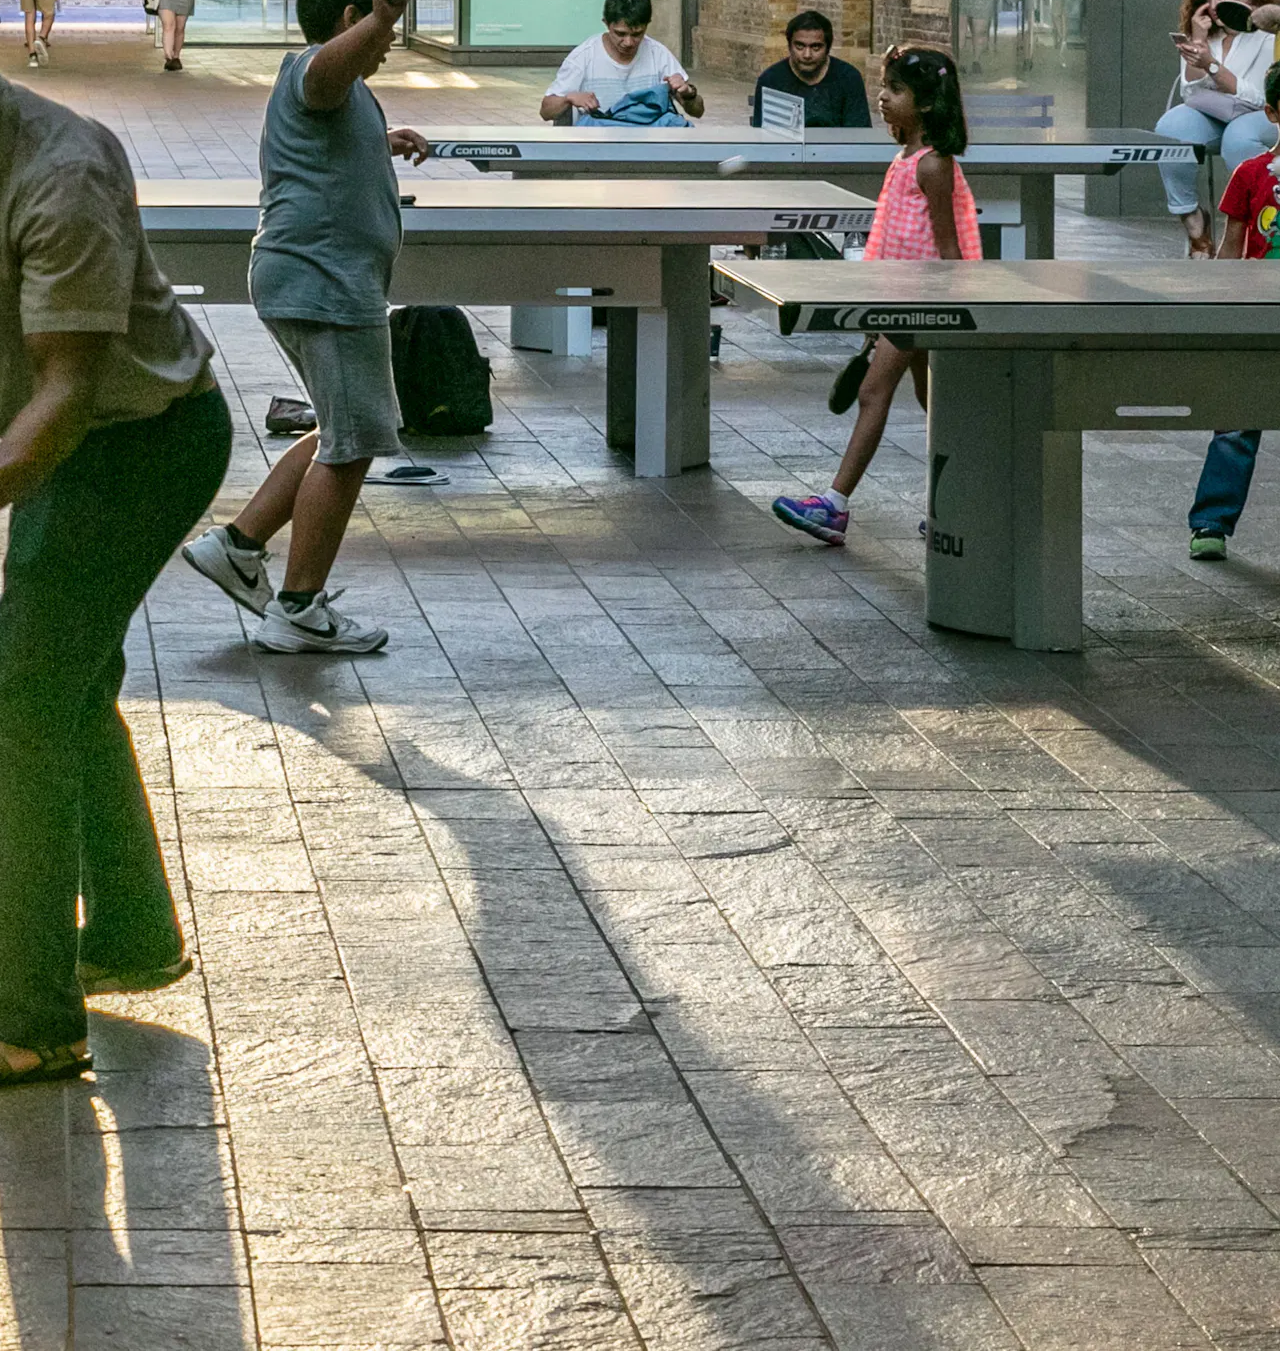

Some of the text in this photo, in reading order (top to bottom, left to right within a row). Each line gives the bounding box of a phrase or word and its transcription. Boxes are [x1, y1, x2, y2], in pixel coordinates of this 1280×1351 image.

[455, 146, 513, 156] cornilleau
[1109, 148, 1163, 161] 510
[770, 213, 839, 230] 510
[867, 312, 961, 326] cornilleau
